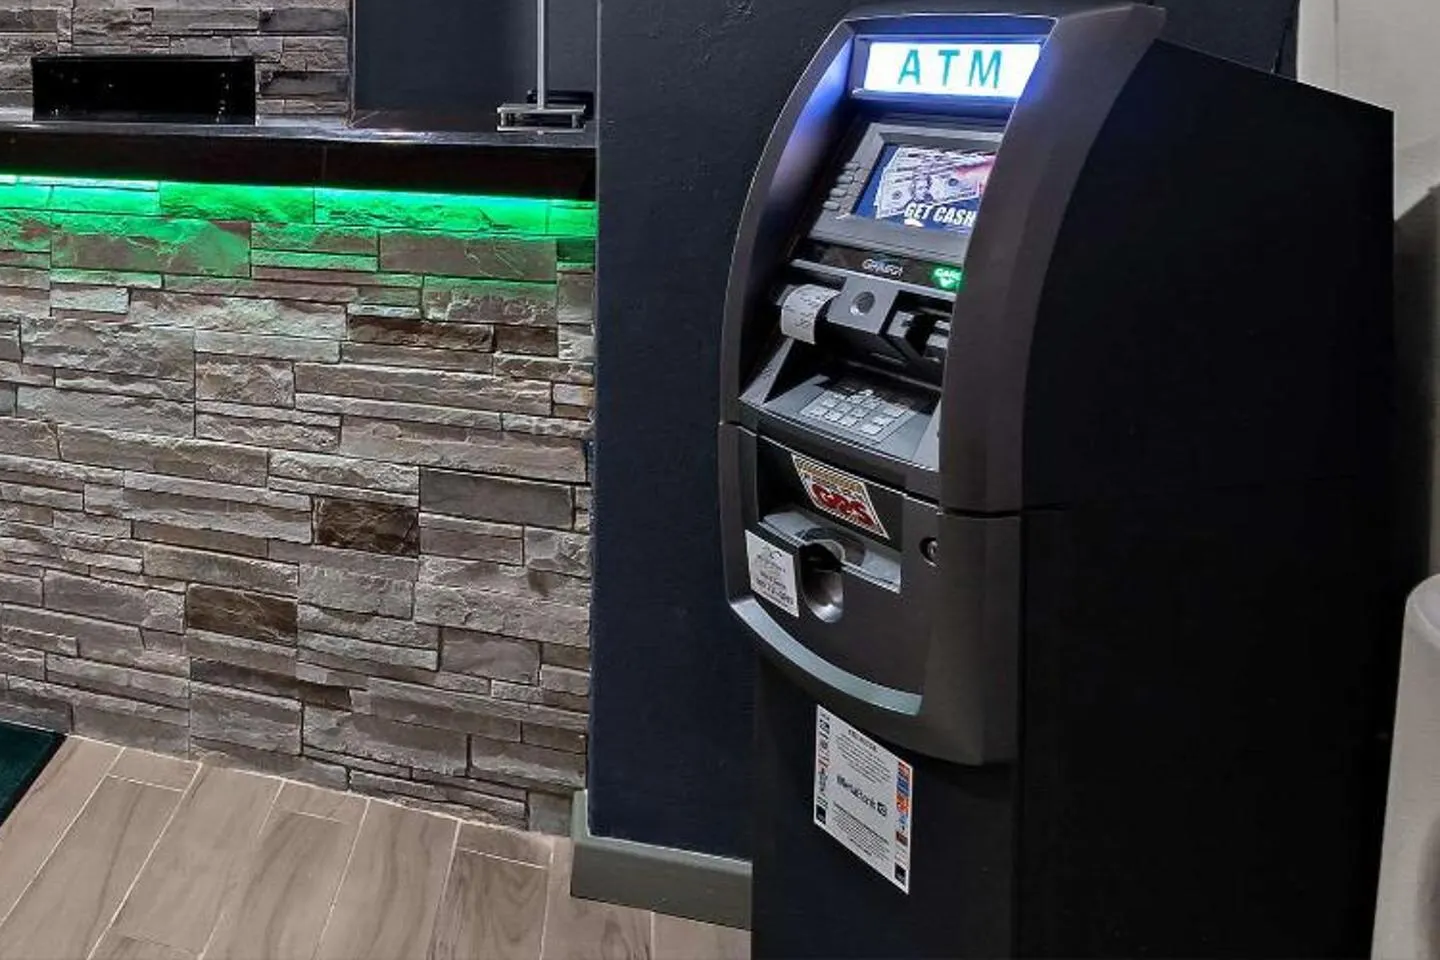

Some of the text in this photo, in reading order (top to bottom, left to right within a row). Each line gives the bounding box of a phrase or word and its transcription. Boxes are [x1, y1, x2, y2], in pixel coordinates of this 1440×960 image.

[897, 49, 1004, 89] ATM
[904, 202, 977, 227] GET CASH
